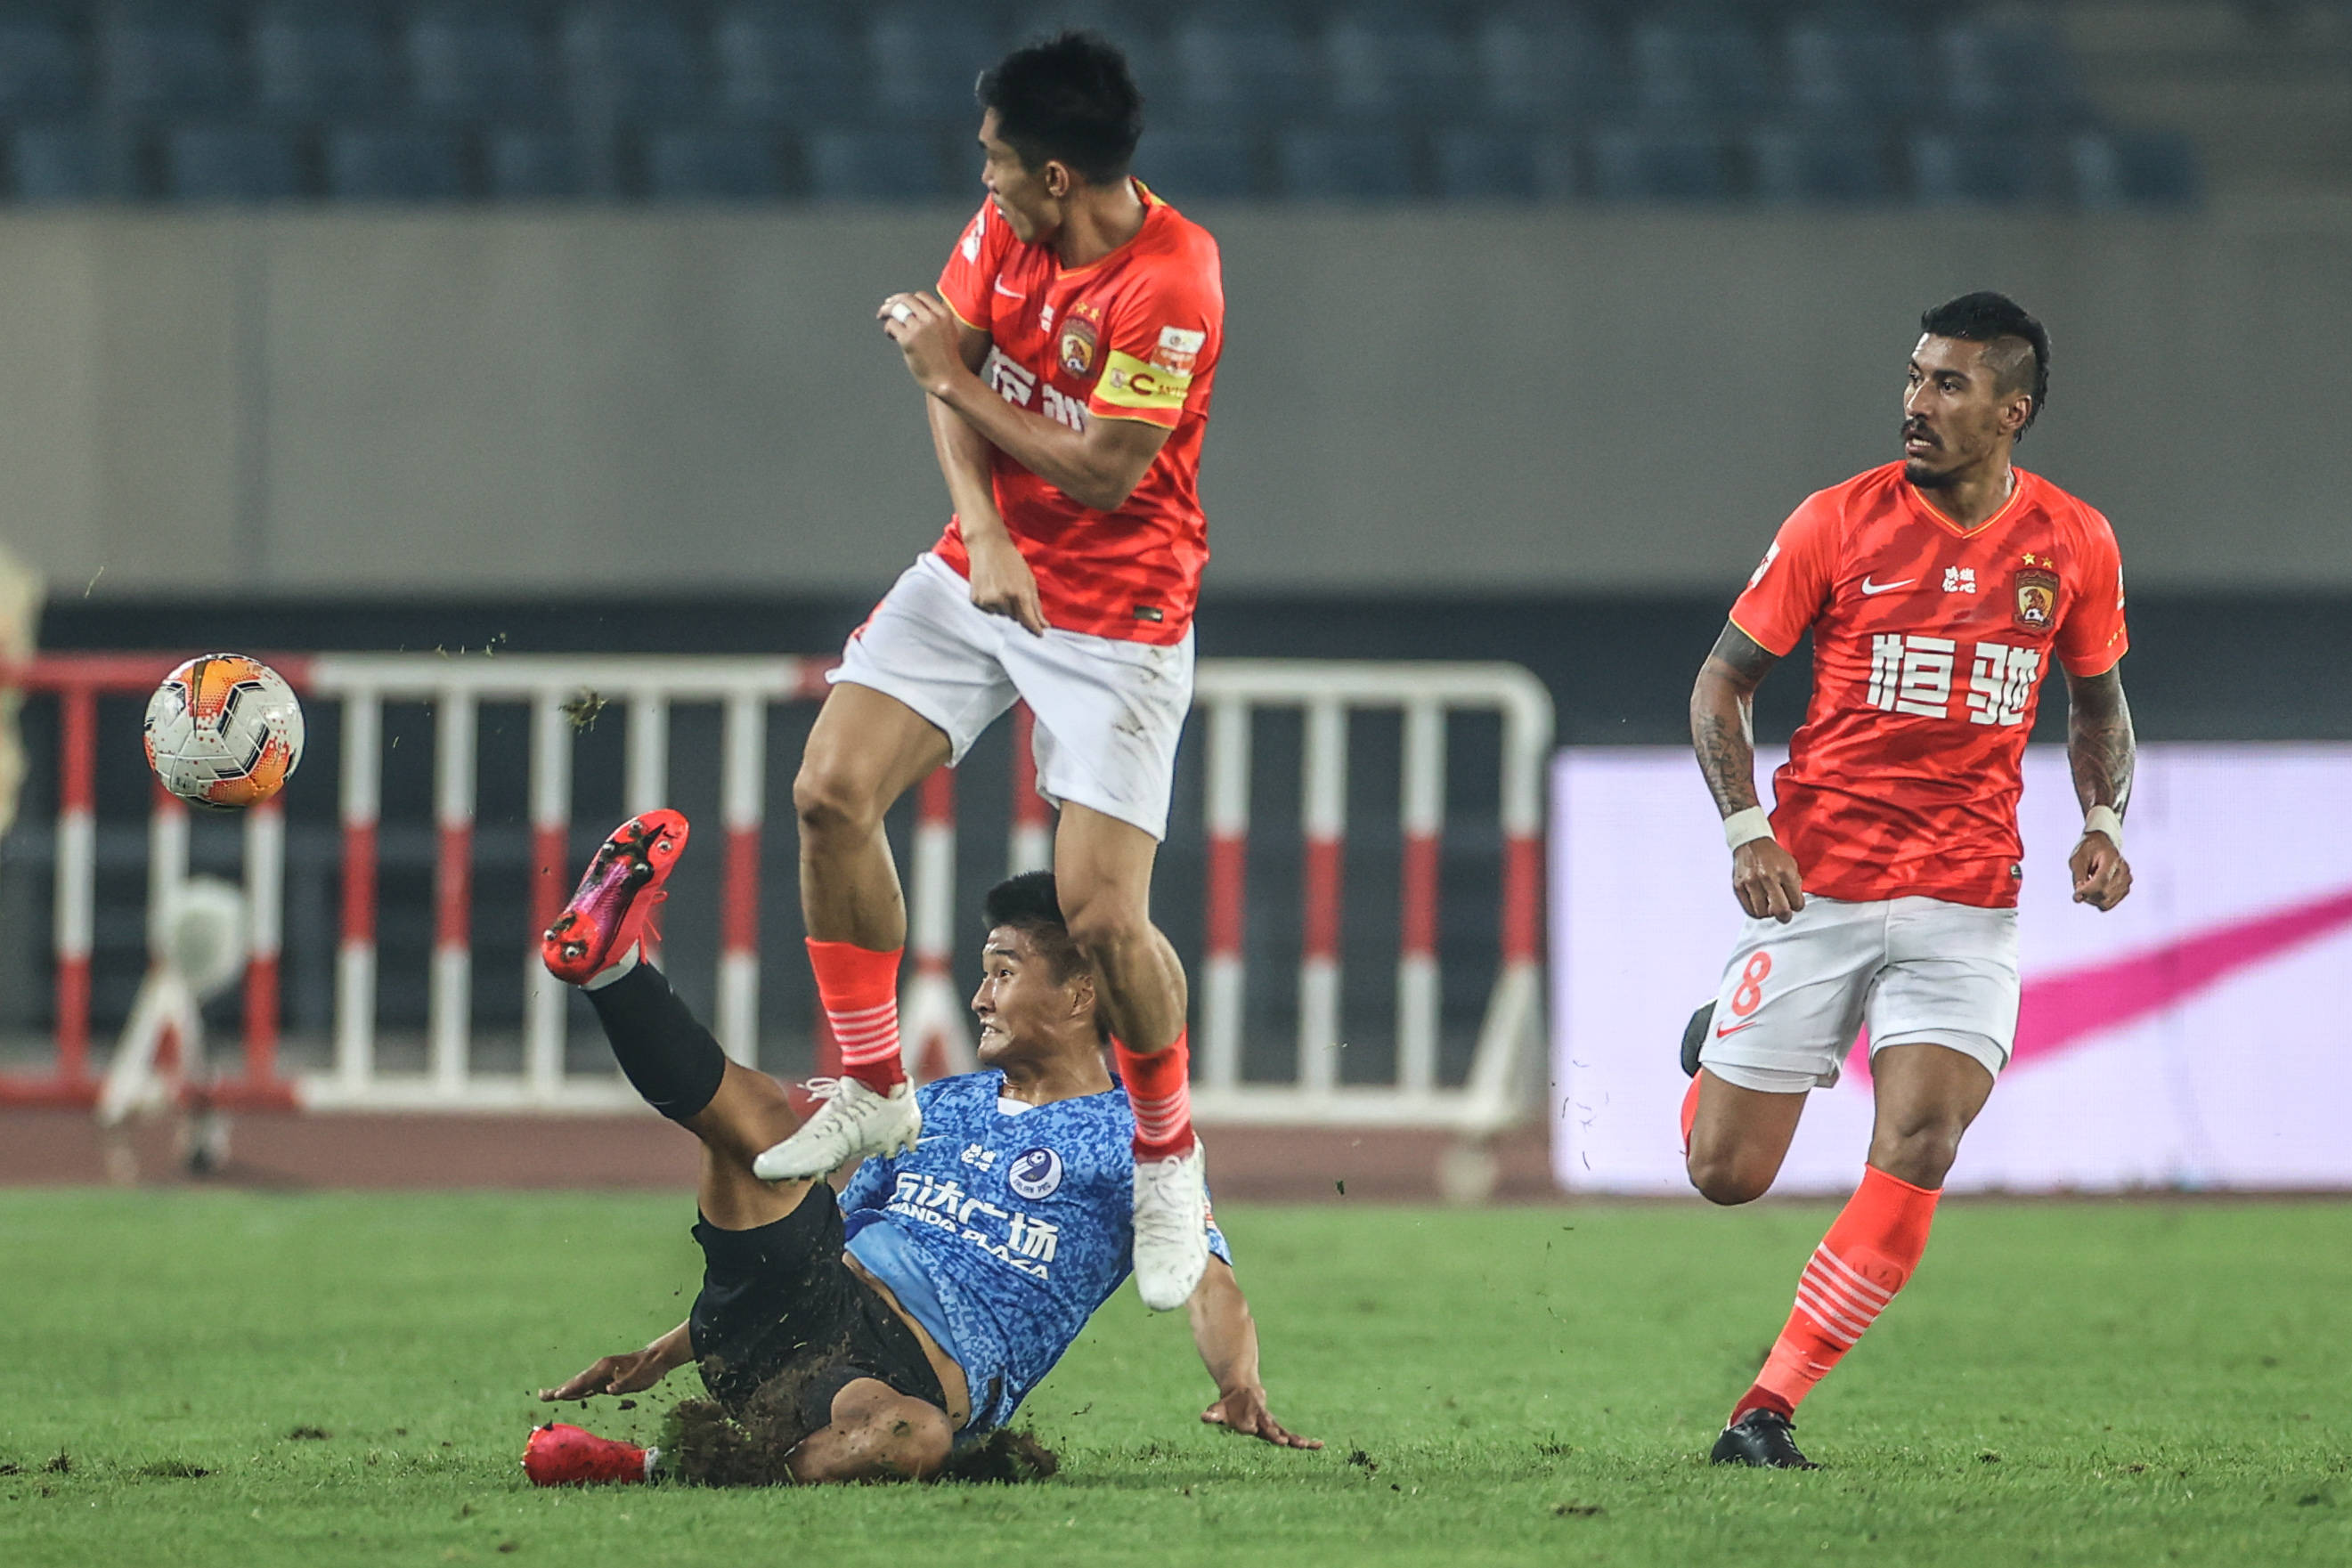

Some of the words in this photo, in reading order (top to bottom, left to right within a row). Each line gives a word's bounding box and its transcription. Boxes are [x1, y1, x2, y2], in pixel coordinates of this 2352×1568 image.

[1867, 634, 2041, 727] 恒驰
[1731, 951, 1772, 1017] 8
[888, 1172, 1059, 1263] 万达广场
[961, 1229, 1050, 1280] PLAZA
